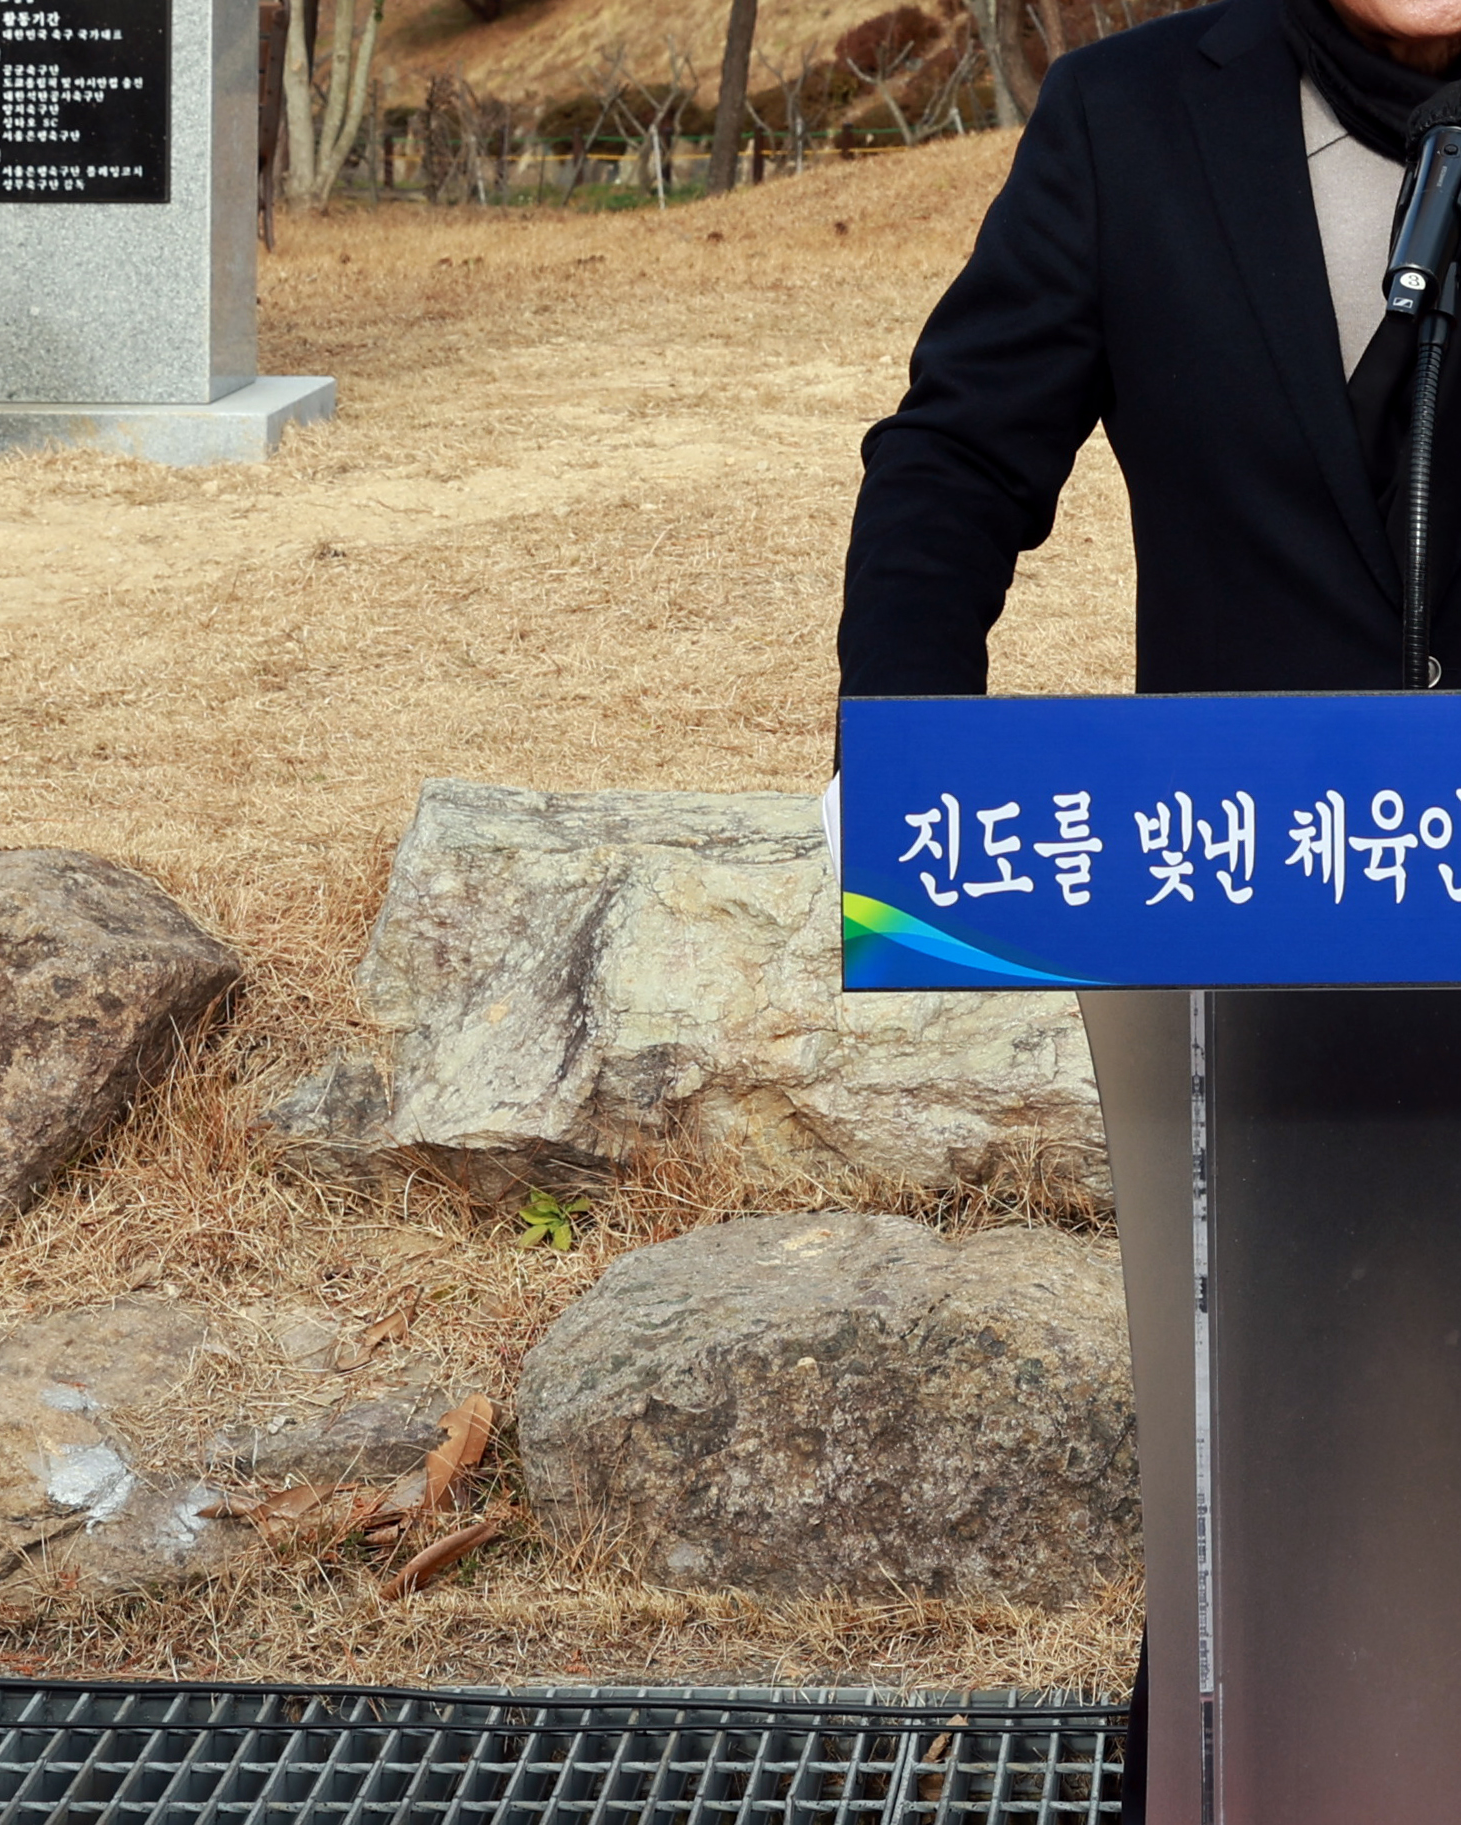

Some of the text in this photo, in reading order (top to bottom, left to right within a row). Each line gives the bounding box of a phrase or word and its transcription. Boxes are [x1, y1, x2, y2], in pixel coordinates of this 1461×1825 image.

[2, 11, 61, 27] 활동기간
[51, 28, 74, 40] 축구
[77, 28, 123, 40] 국가대표
[1408, 274, 1420, 287] 3
[899, 791, 1102, 906] 진도를
[1135, 791, 1254, 905] 빛낸
